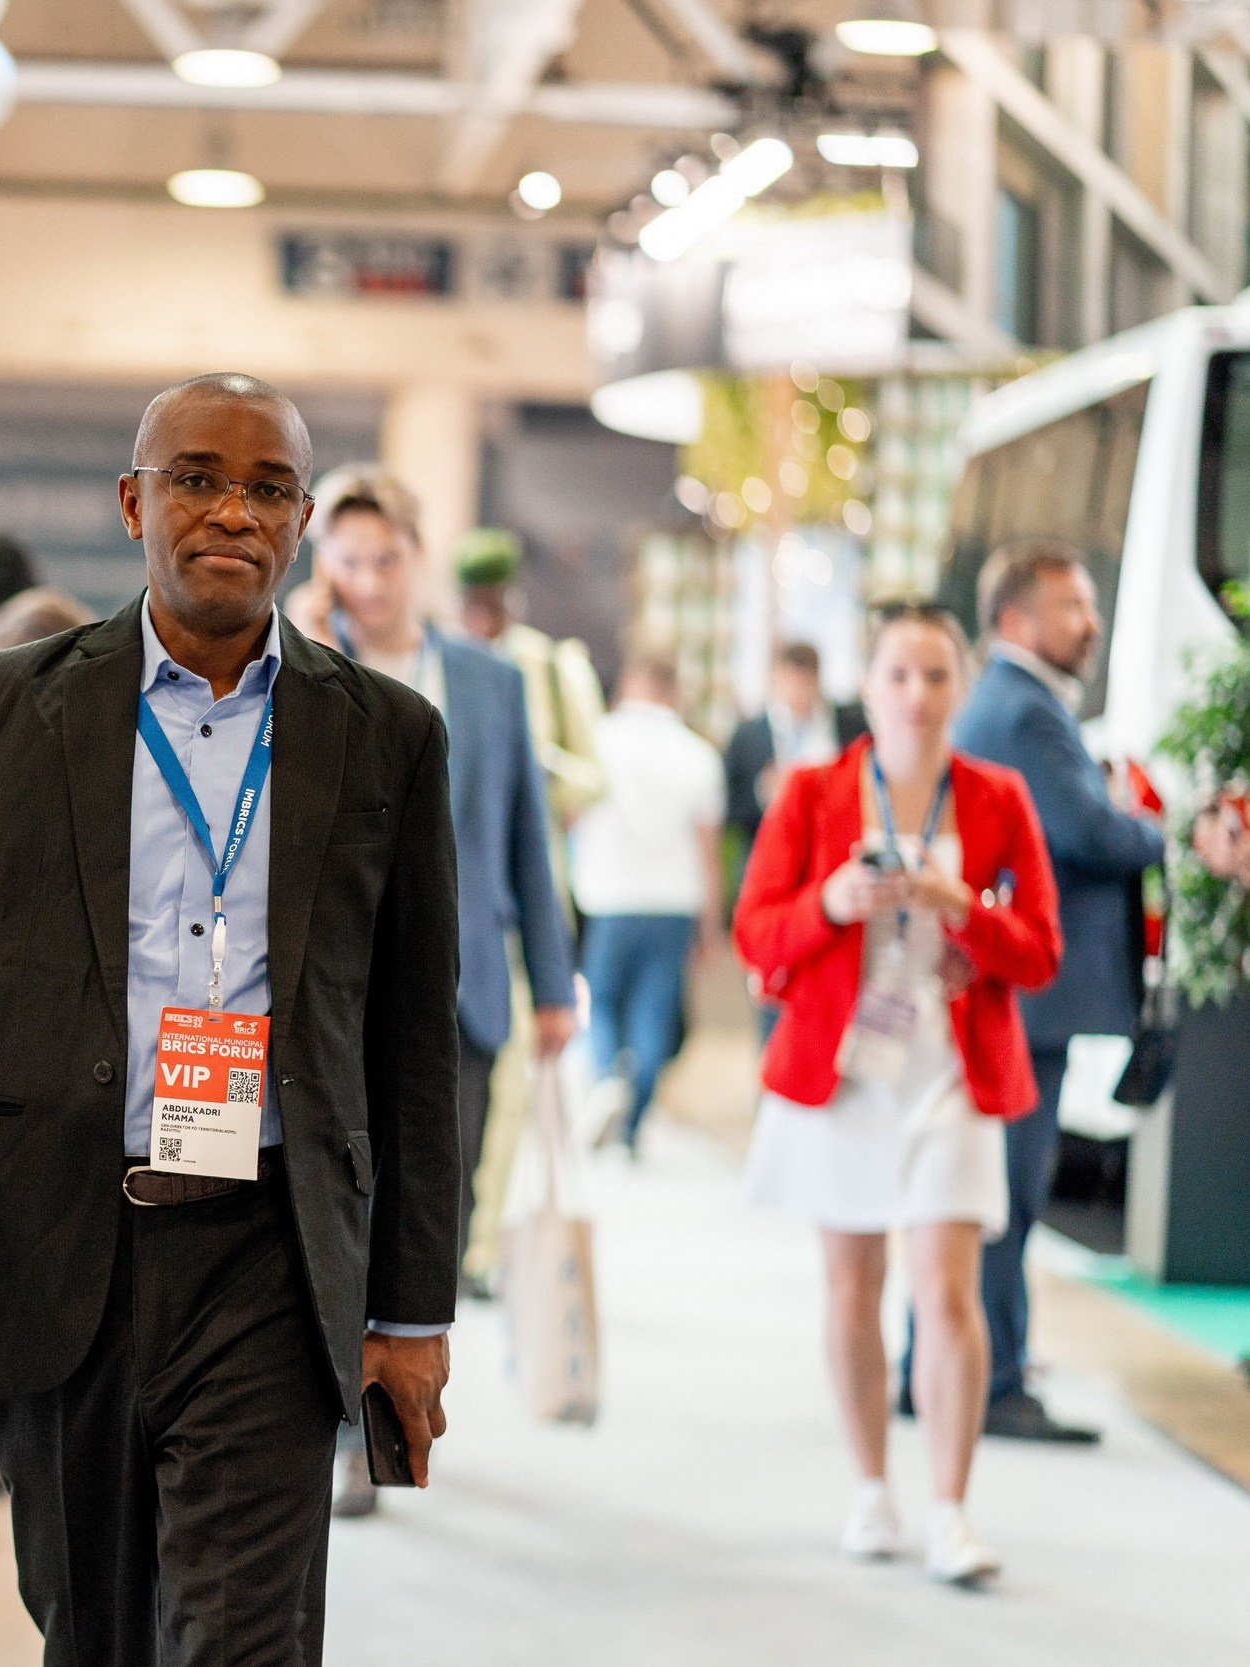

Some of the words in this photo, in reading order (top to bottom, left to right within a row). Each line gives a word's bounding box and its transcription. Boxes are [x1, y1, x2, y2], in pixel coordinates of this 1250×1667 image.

[235, 788, 256, 836] IMBRICS
[162, 1032, 223, 1044] INTERNATIONAL
[224, 1038, 264, 1048] MUNICIPAL
[161, 1039, 206, 1055] BRICS
[210, 1043, 265, 1060] FORUM
[160, 1062, 210, 1088] VIP
[161, 1113, 194, 1123] KHAMA
[162, 1104, 221, 1116] ABDULKADRI
